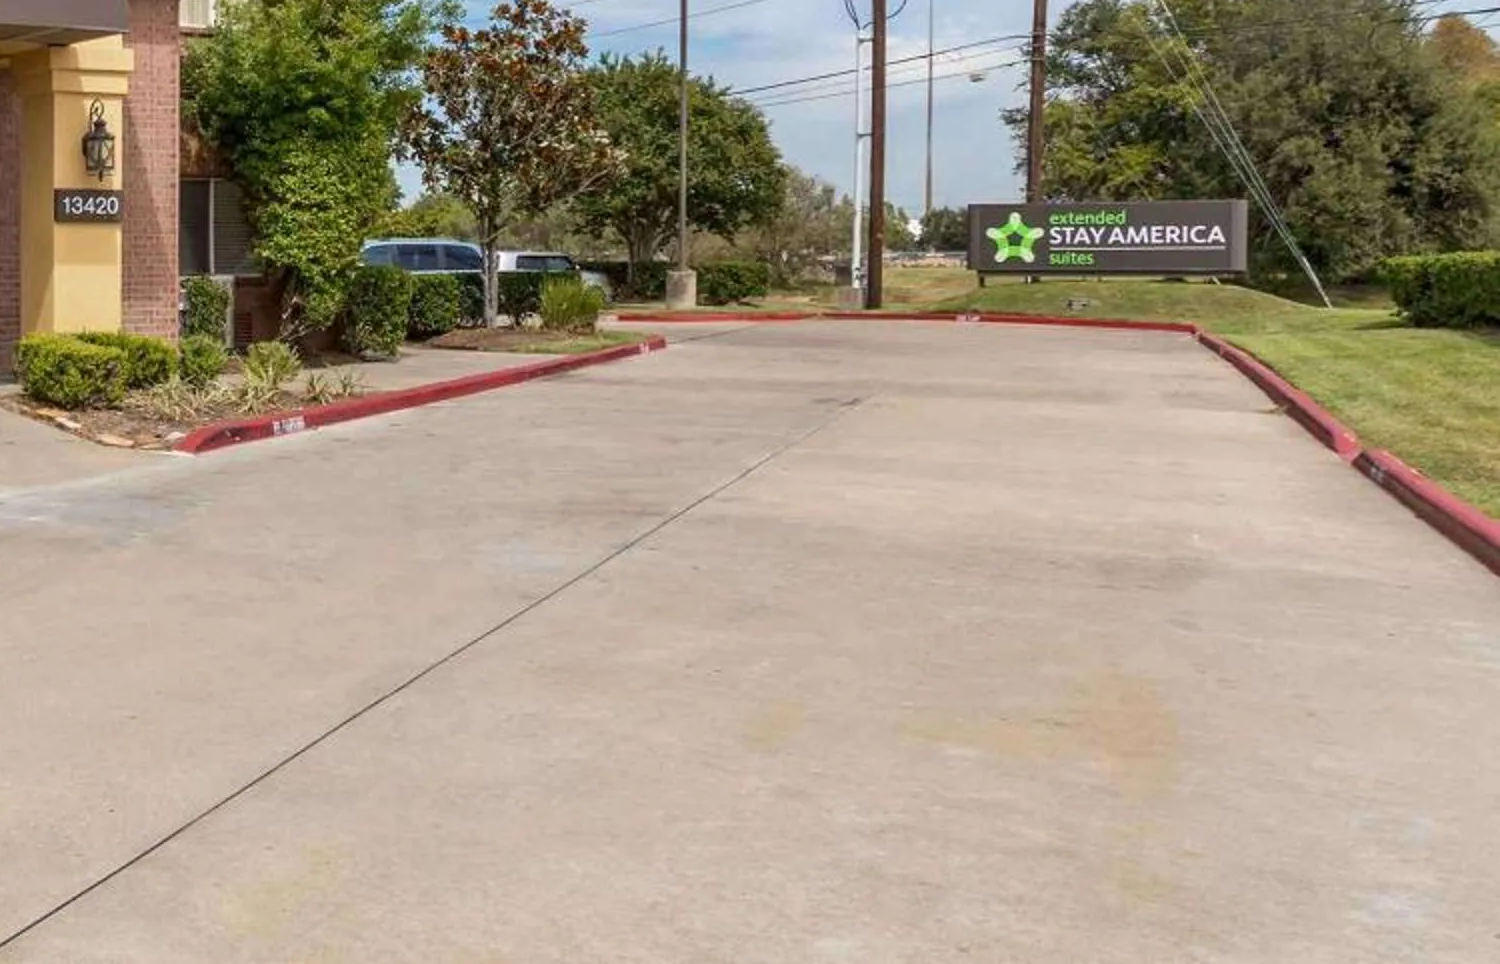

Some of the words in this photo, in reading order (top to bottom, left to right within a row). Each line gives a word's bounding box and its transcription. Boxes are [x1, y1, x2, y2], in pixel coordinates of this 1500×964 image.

[62, 197, 119, 214] 13420
[1050, 210, 1126, 225] extended
[1050, 227, 1103, 244] STAY
[1107, 225, 1226, 243] AMERICA
[1050, 251, 1094, 265] suites
